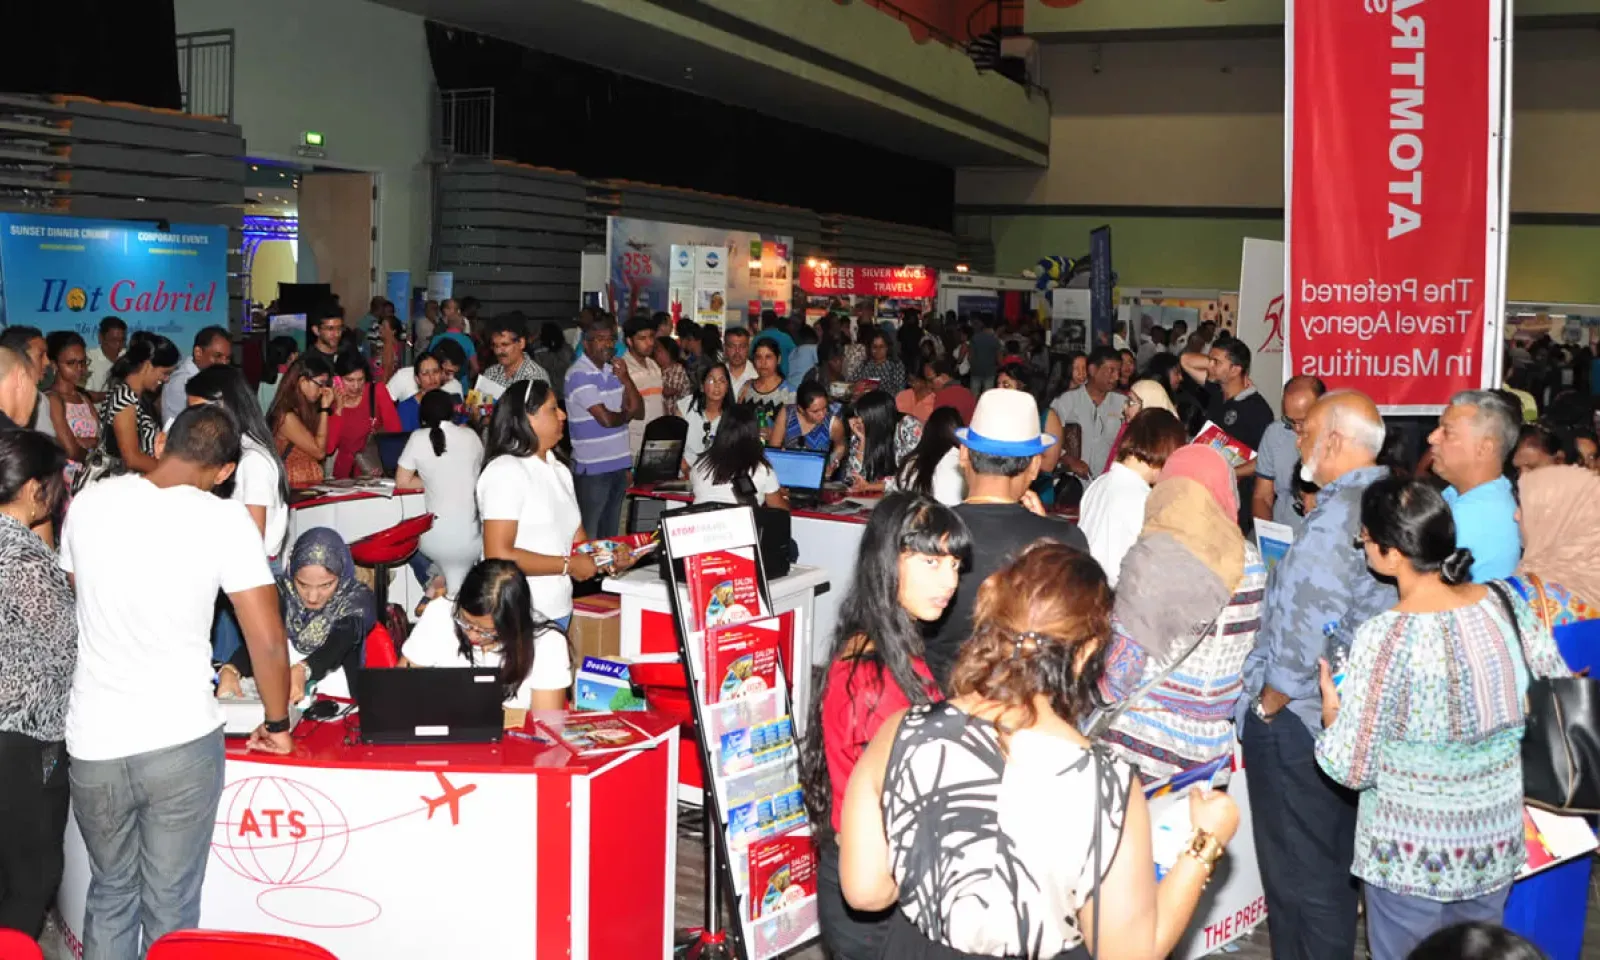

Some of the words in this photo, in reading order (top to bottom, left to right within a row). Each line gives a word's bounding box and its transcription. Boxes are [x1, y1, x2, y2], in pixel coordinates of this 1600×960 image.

[10, 224, 45, 237] SUNSET
[137, 231, 181, 243] CORPORATE
[182, 234, 209, 244] EVENTS
[815, 266, 854, 277] SUPER
[861, 267, 891, 278] SILVER
[814, 277, 855, 289] SALES
[874, 282, 913, 293] TRAVELS
[109, 279, 216, 312] Gabriel
[585, 660, 612, 673] Double
[238, 808, 307, 838] ATS
[1204, 916, 1232, 949] THE
